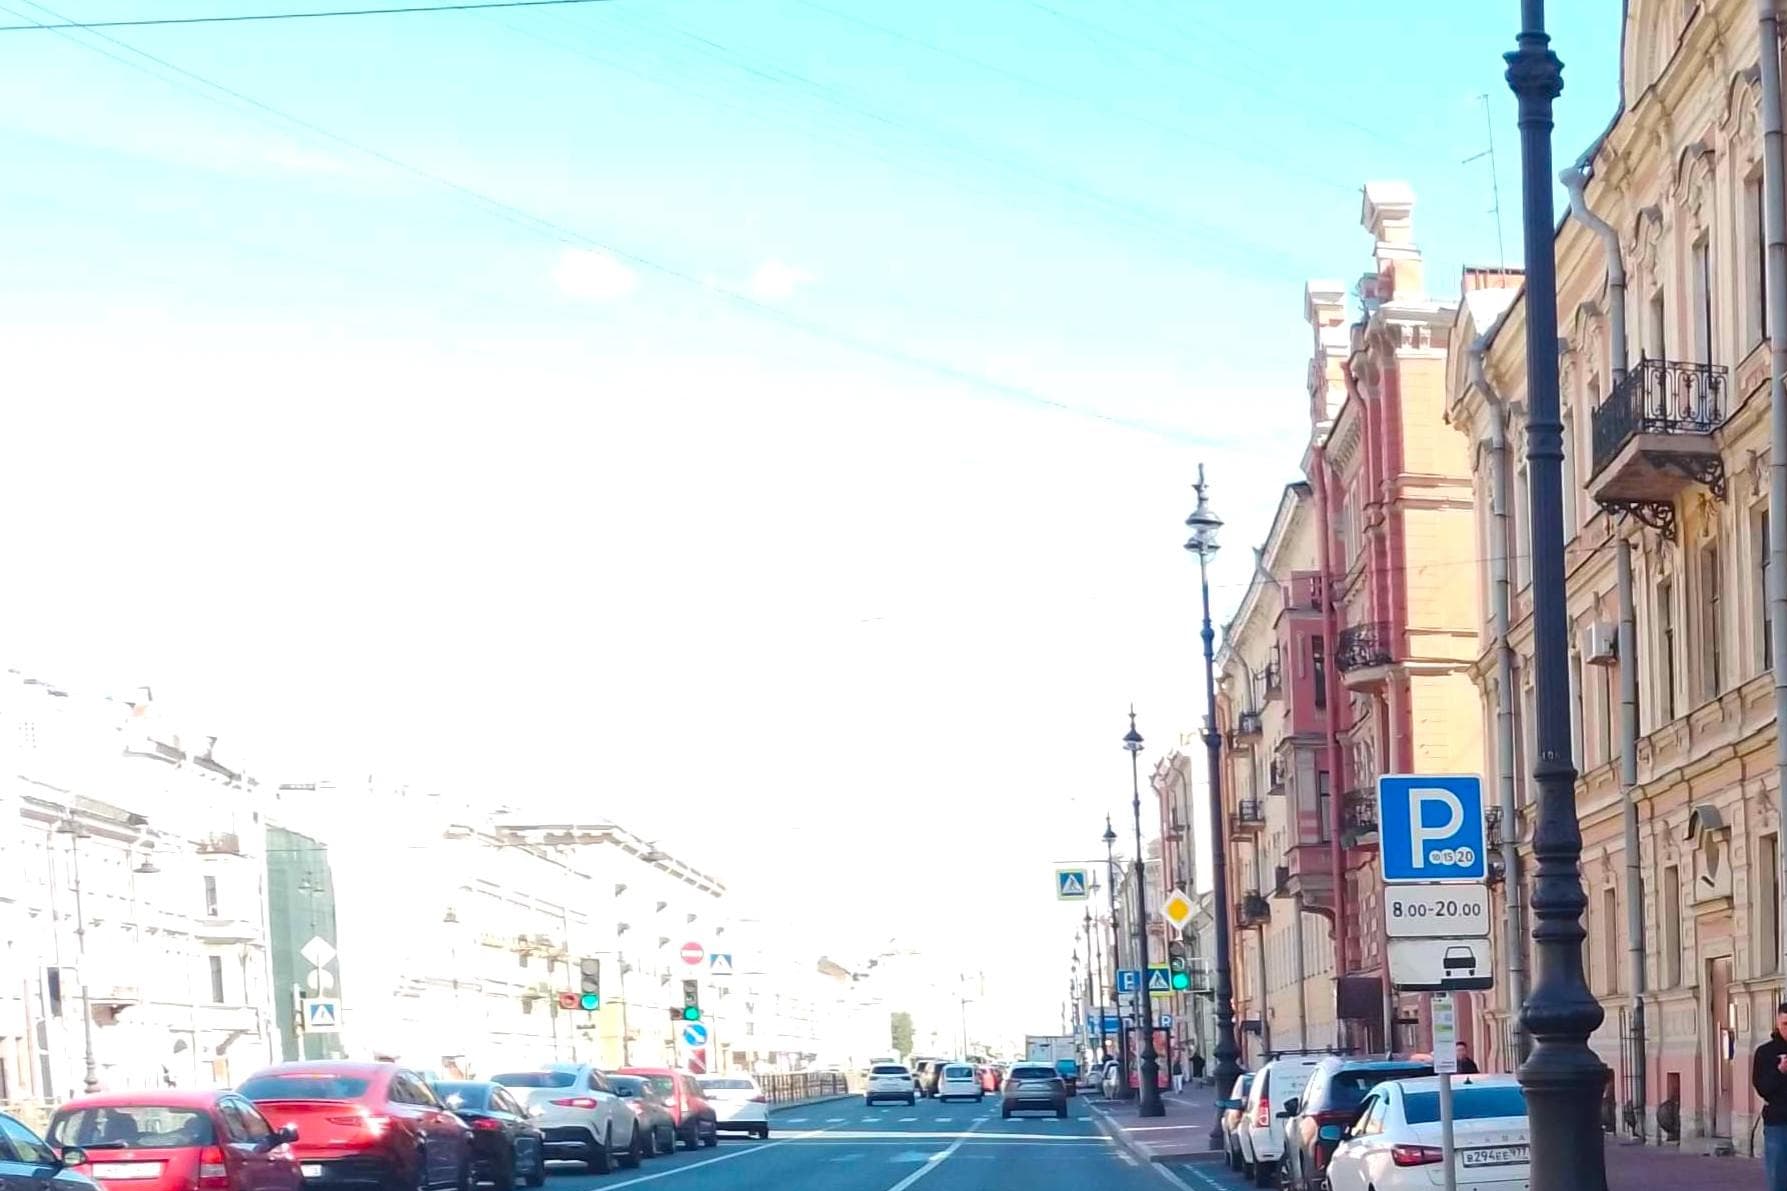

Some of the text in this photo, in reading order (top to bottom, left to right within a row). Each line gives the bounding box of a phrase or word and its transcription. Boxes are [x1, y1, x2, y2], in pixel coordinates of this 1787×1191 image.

[1408, 788, 1465, 869] P
[1443, 852, 1453, 862] 15
[1457, 850, 1473, 862] 20
